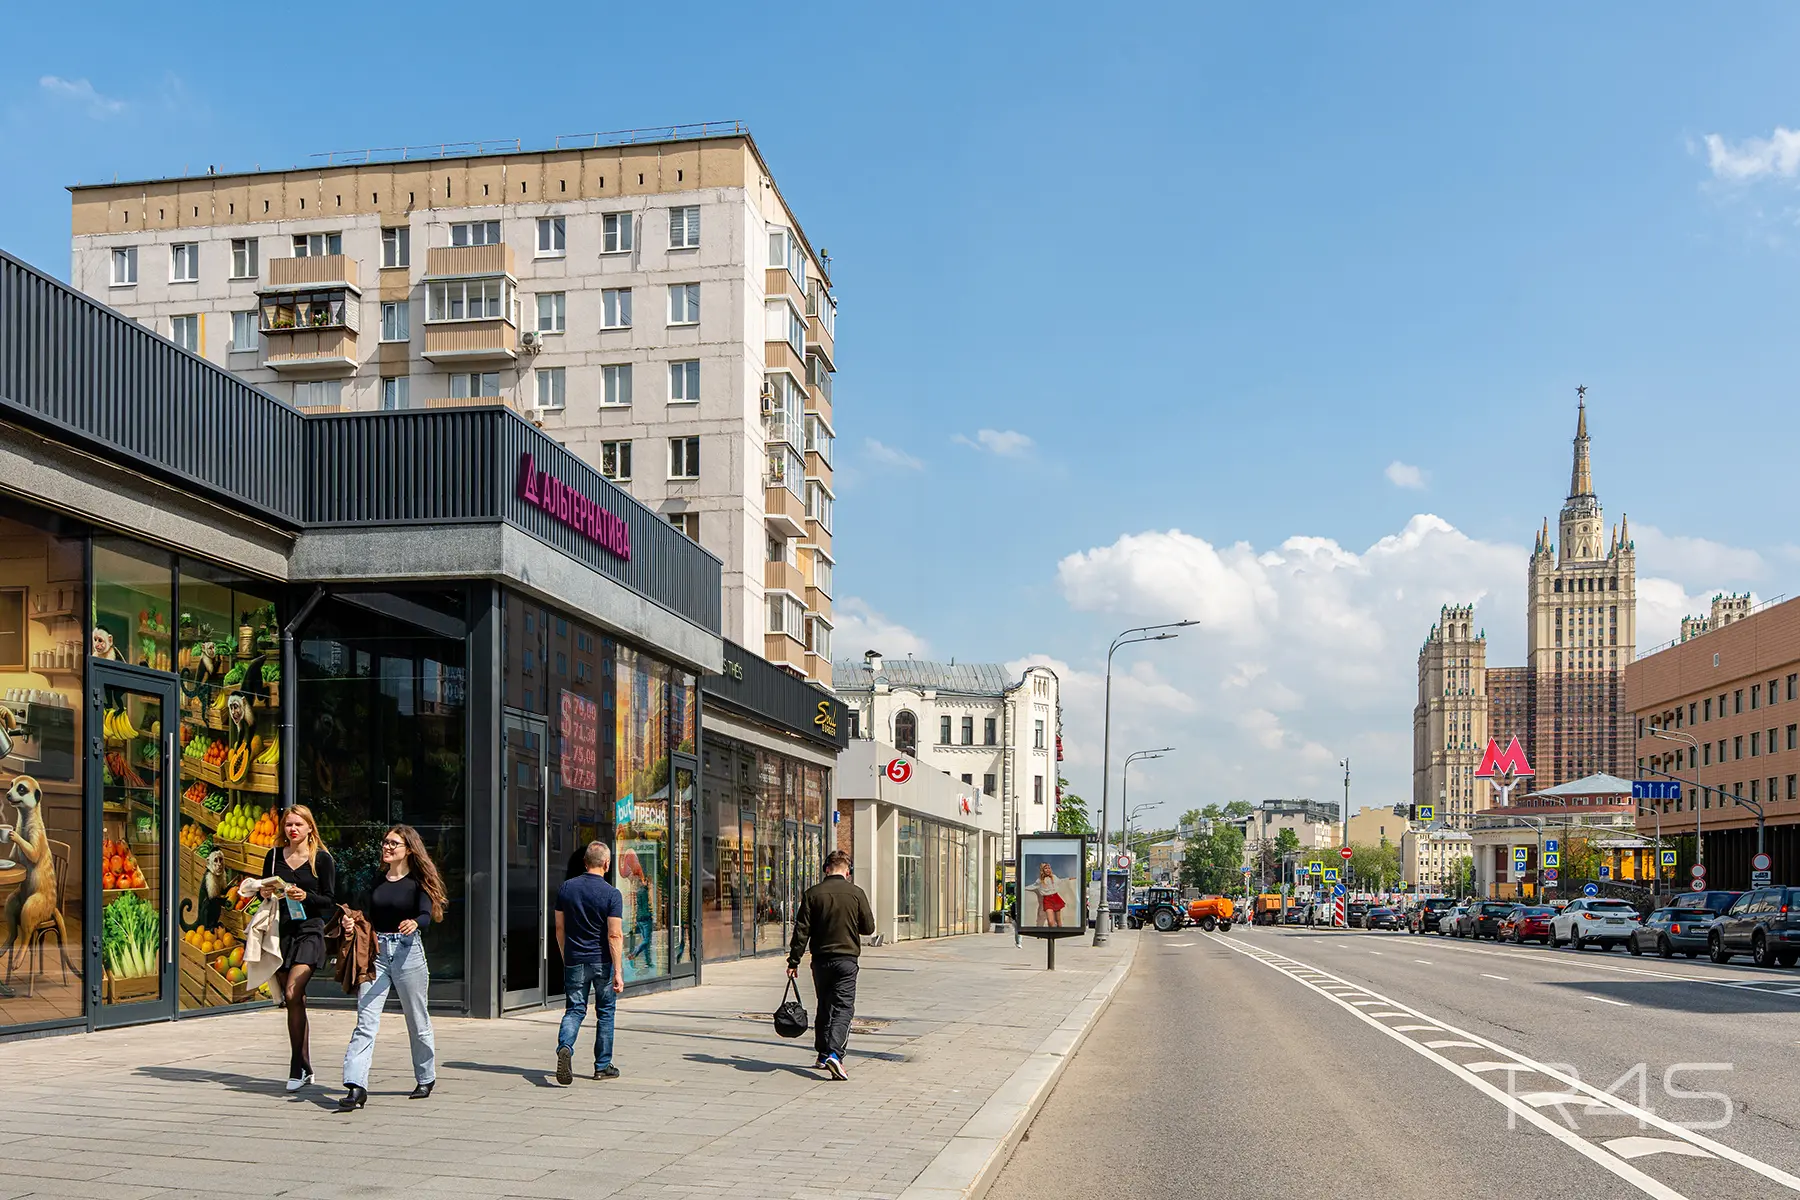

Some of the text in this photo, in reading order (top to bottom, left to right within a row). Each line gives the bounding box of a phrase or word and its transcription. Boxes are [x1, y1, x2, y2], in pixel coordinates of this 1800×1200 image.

[542, 471, 631, 562] АЛЬТЕРНАТИВА
[822, 723, 836, 737] BURGER
[891, 759, 907, 779] 5
[634, 805, 666, 827] ПРЕСНЯ
[1517, 862, 1524, 870] P
[1601, 867, 1608, 875] P
